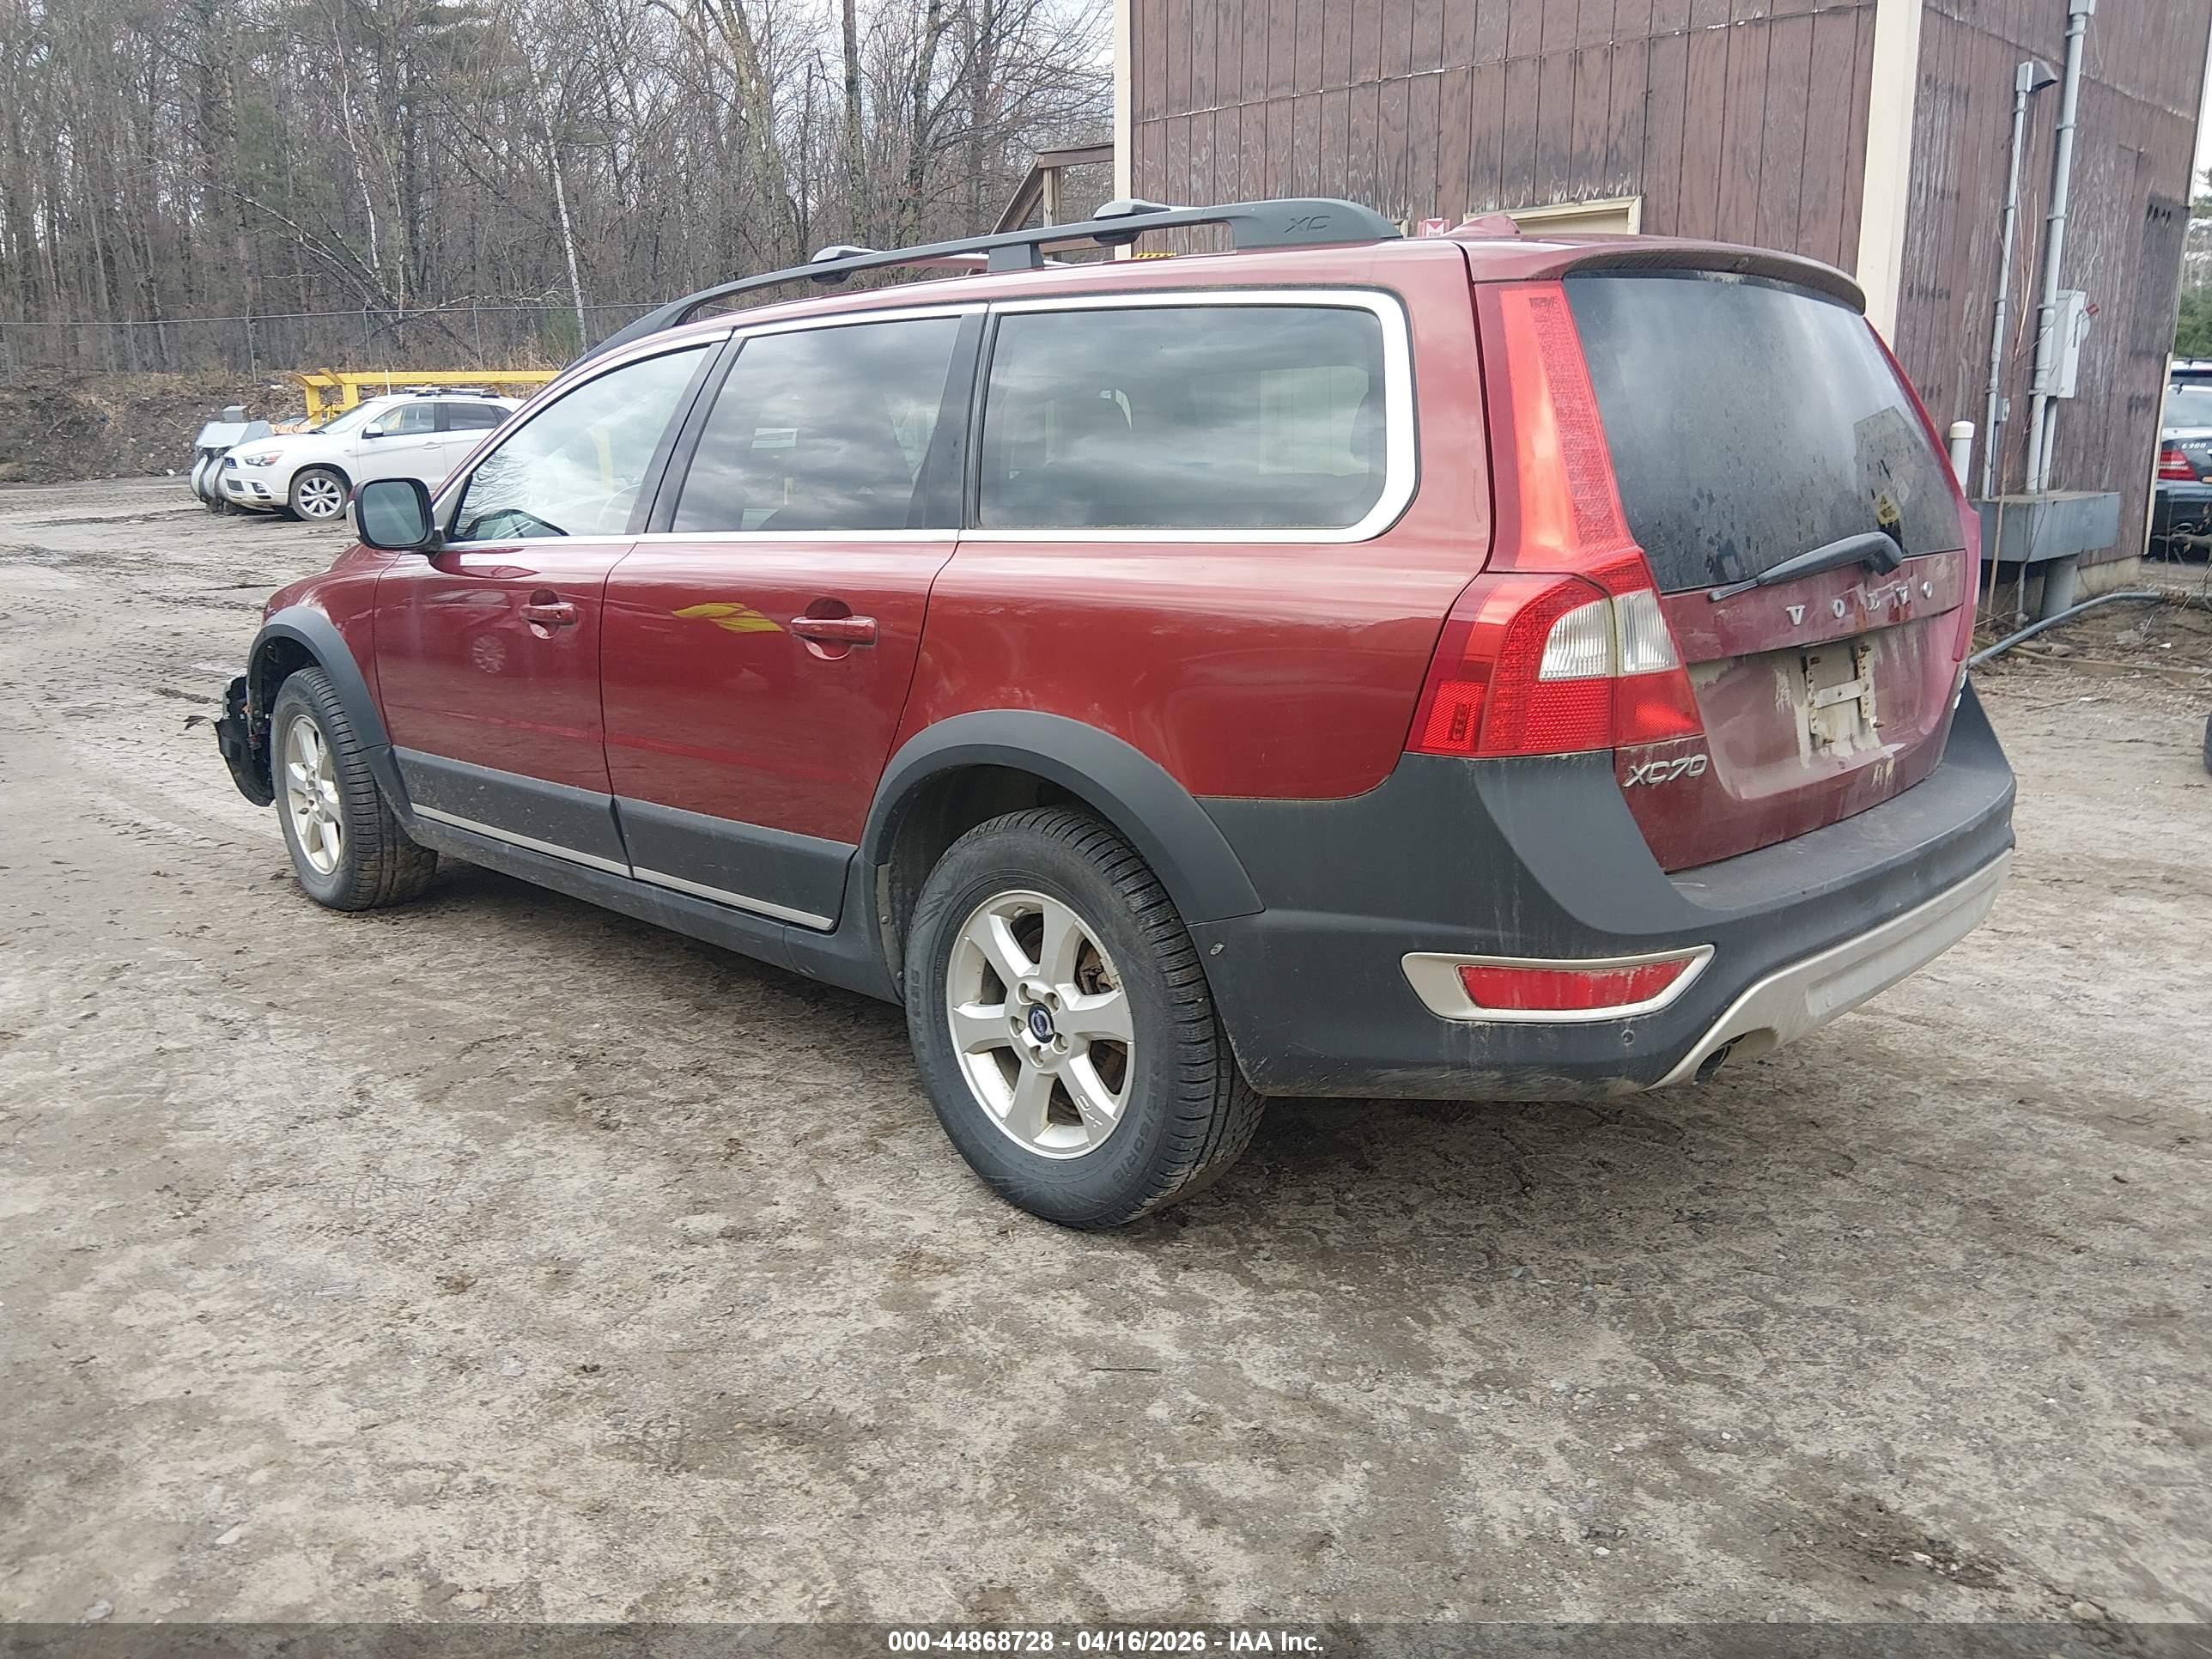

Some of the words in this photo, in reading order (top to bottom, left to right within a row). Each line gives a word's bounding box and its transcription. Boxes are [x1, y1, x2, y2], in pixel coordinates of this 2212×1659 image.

[1284, 216, 1331, 233] XC
[1785, 580, 1933, 626] VOLVO
[1622, 755, 1707, 787] XC70
